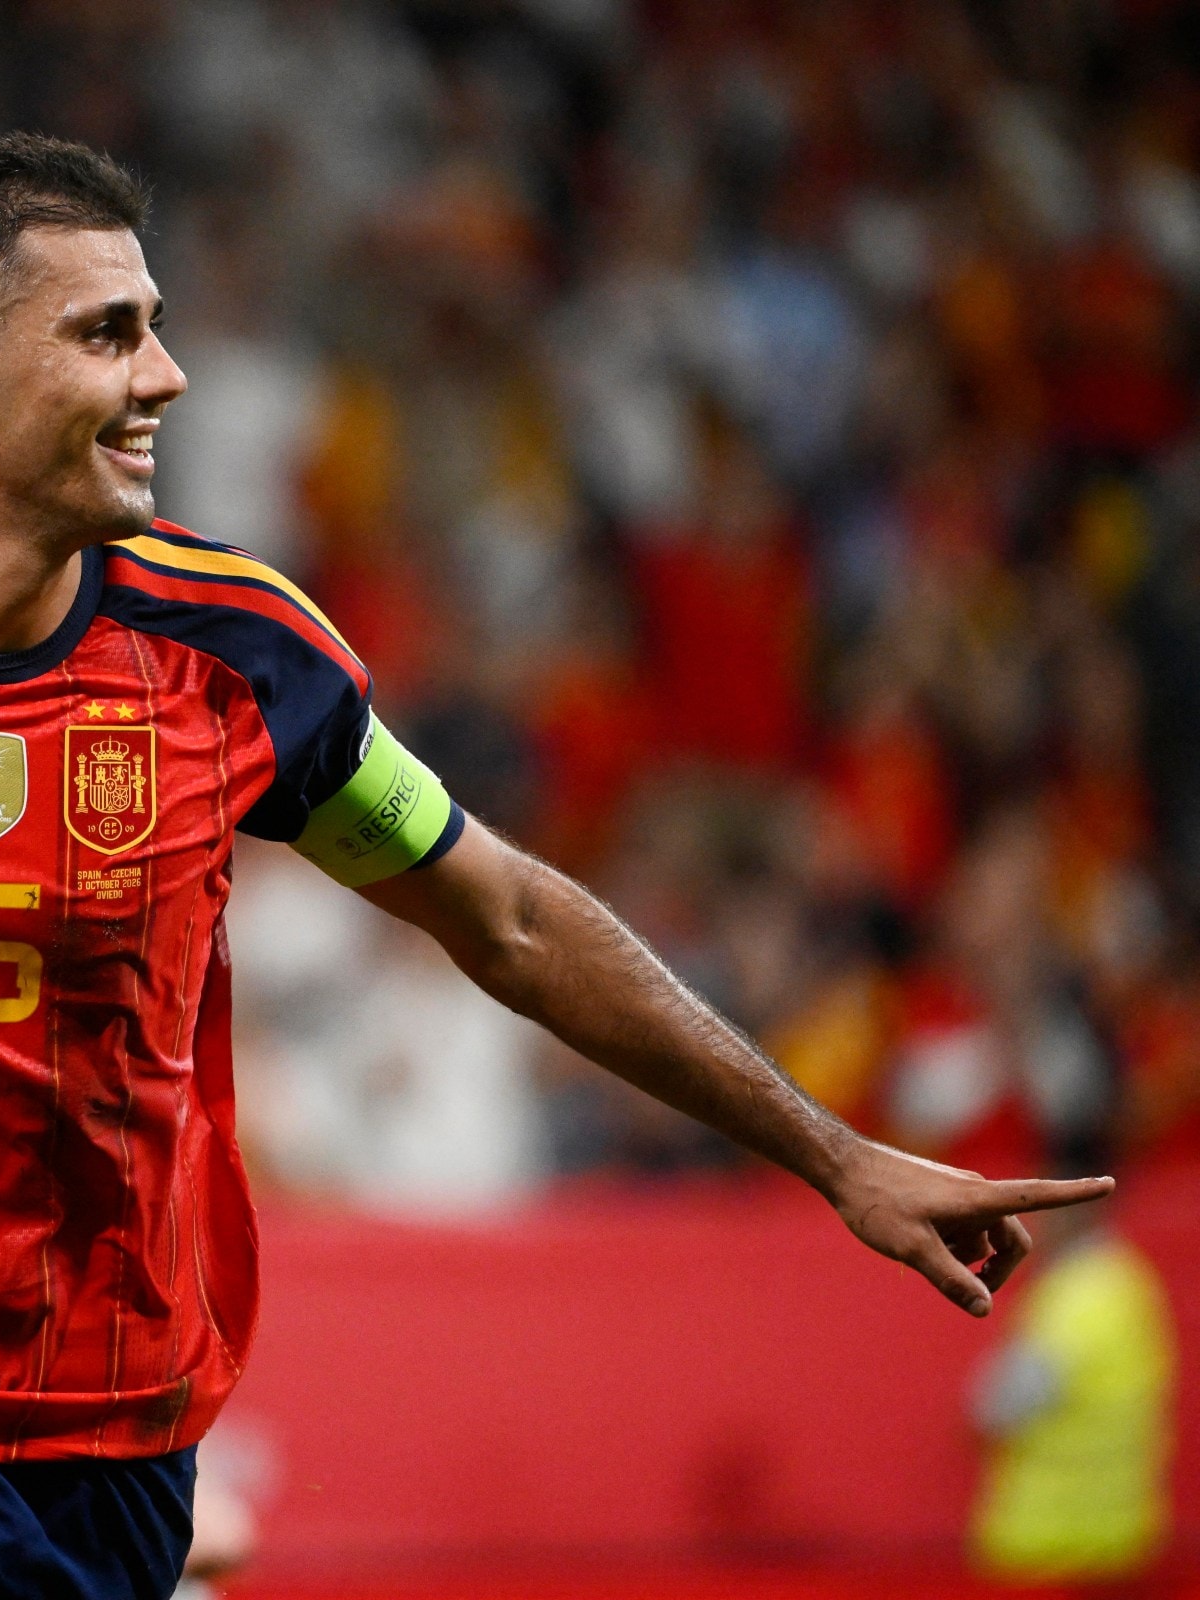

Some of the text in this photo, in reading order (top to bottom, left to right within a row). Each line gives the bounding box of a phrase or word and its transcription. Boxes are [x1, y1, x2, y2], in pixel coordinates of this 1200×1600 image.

[358, 767, 416, 843] RESPECT
[87, 824, 96, 833] 19
[77, 870, 102, 880] SPAIN
[110, 867, 142, 879] CZECHIA
[77, 877, 142, 890] 3 OCTOBER 2026
[96, 889, 123, 900] OVIEDO
